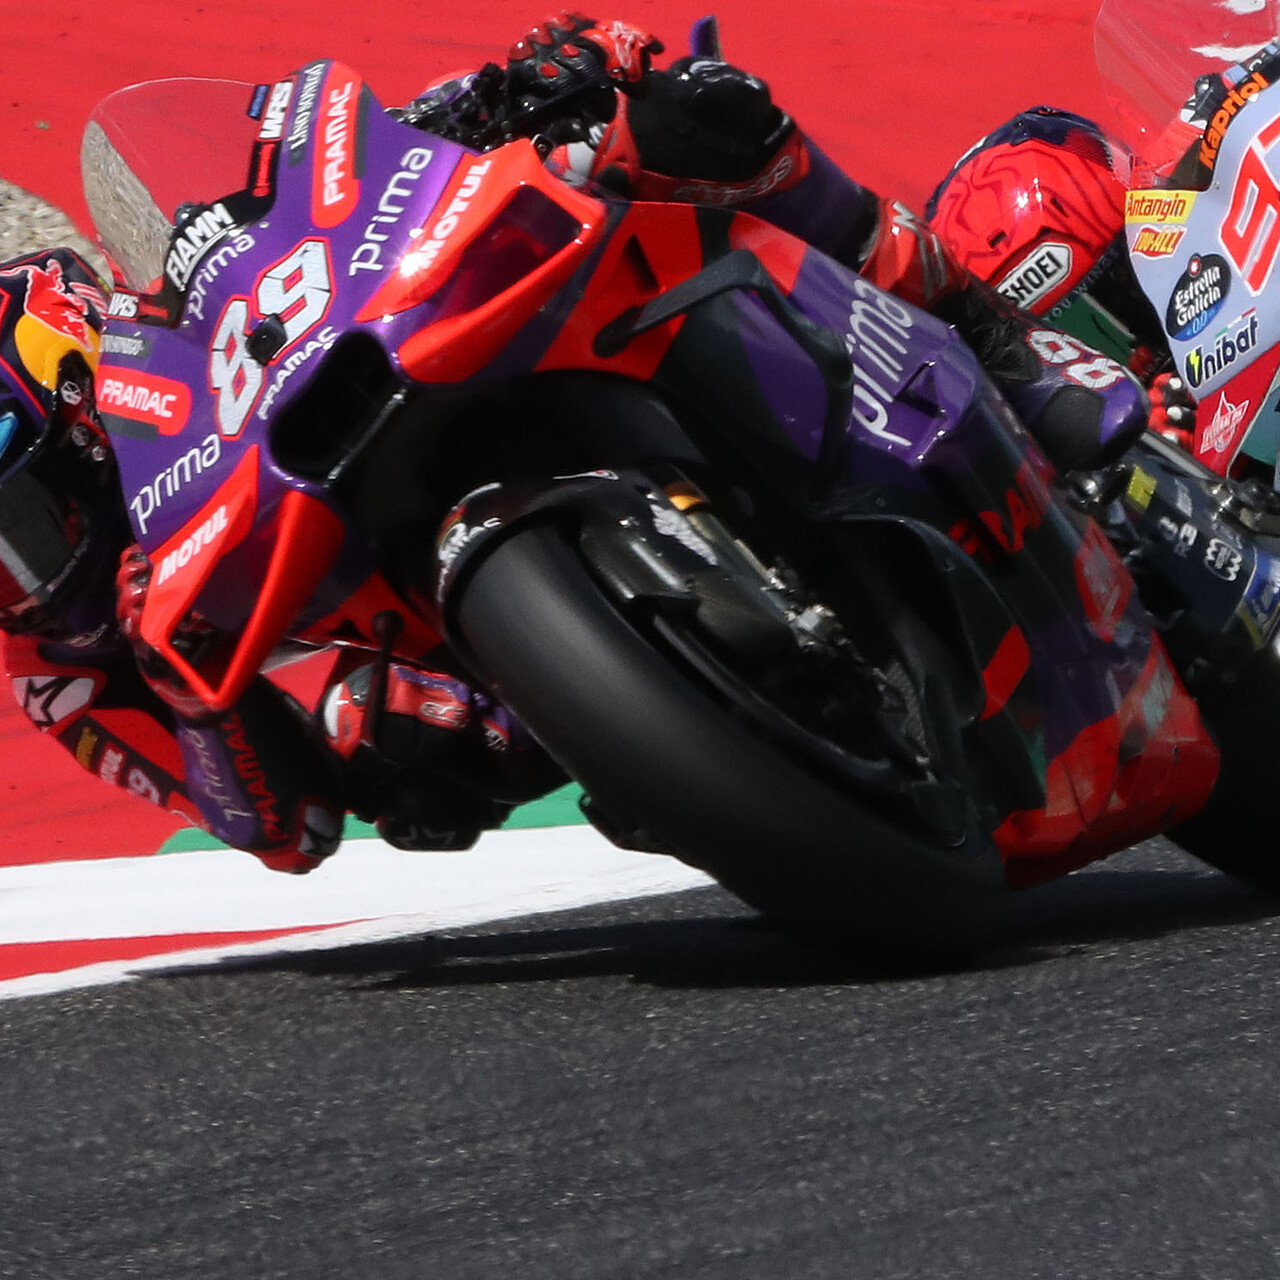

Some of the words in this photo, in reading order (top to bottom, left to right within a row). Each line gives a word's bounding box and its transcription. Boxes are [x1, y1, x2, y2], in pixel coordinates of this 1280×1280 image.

[323, 81, 354, 207] PRAMAC
[1199, 72, 1270, 171] Kapriol
[165, 202, 235, 290] FIAMM
[348, 146, 434, 278] prima
[413, 160, 492, 270] MOTUL
[1127, 193, 1187, 222] Antangin
[187, 231, 256, 321] prima
[1003, 251, 1064, 304] SHOEI
[1174, 265, 1221, 310] Estrella
[1176, 286, 1222, 326] Galicia
[211, 238, 334, 438] 89
[847, 277, 915, 447] prima
[1185, 315, 1260, 390] Unibat
[99, 378, 177, 418] PRAMAC
[130, 433, 221, 535] prima
[157, 504, 229, 586] MOTUL
